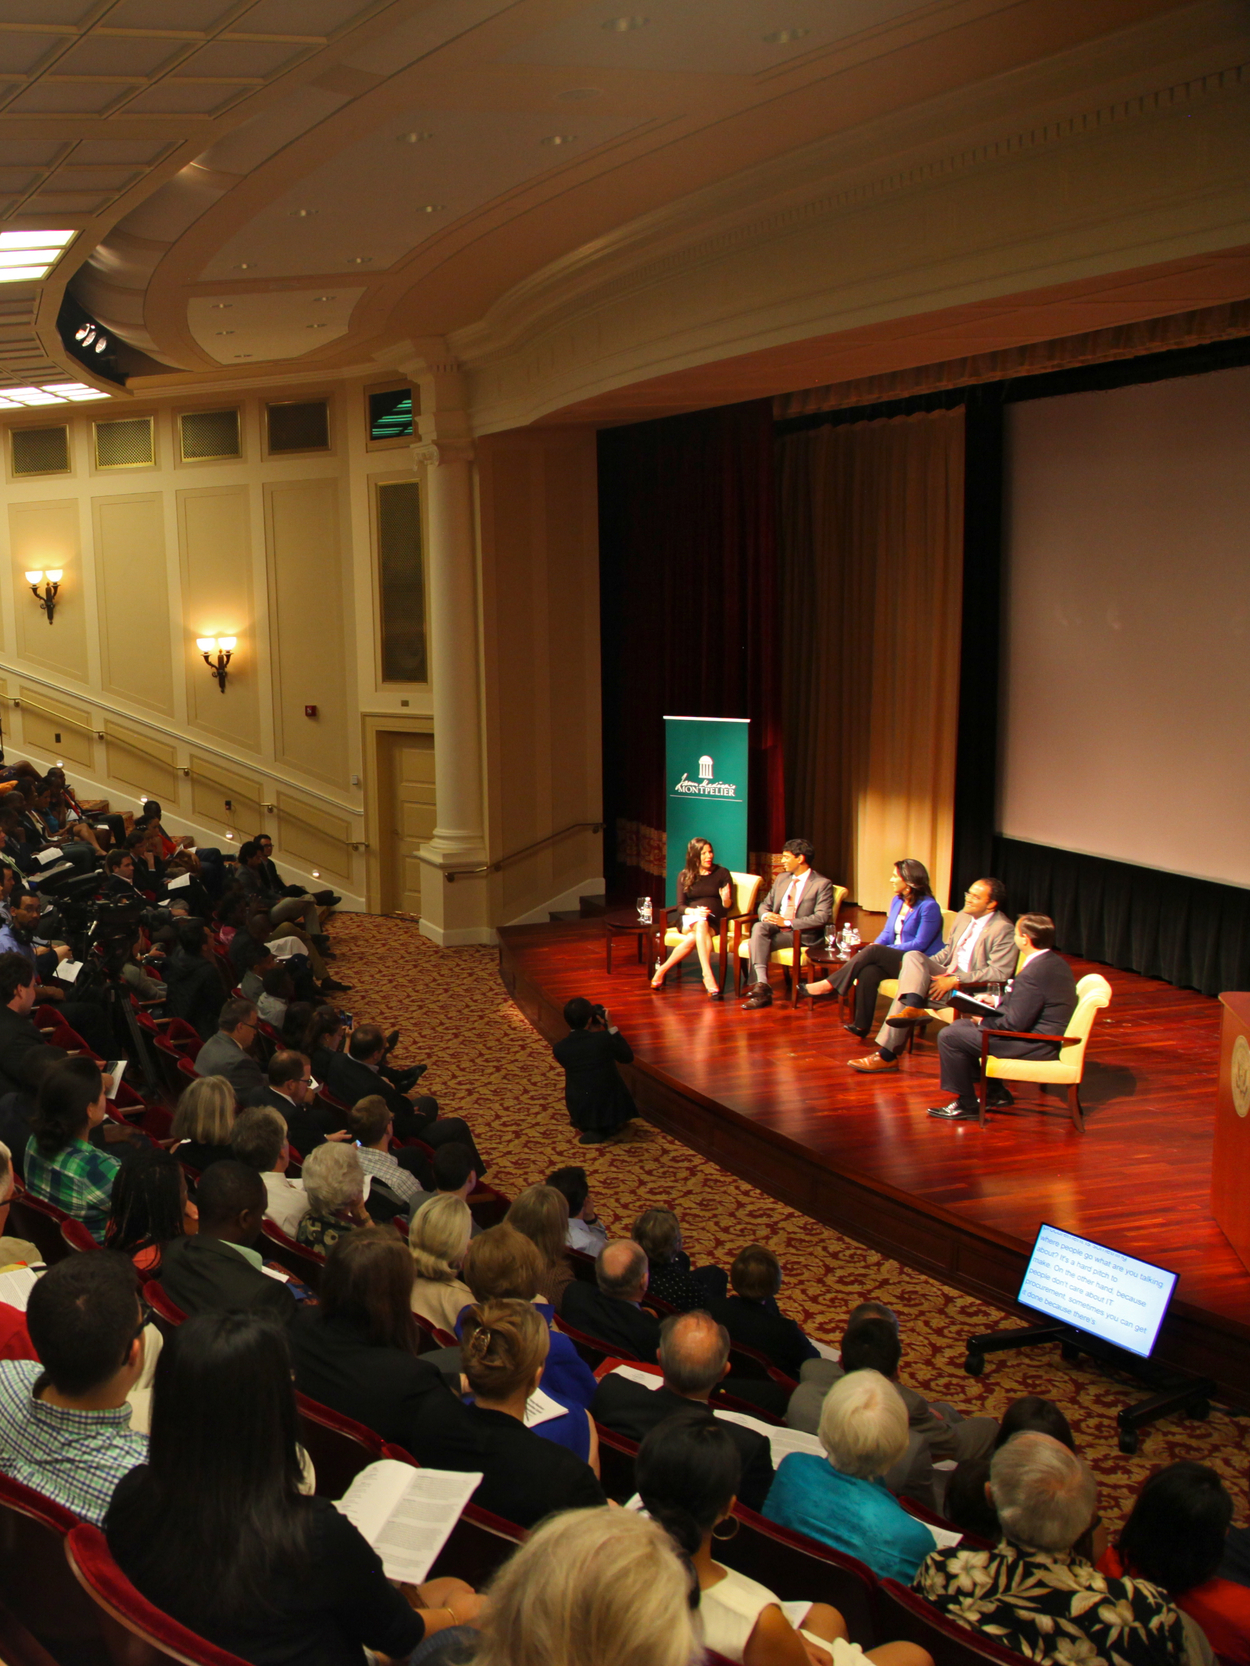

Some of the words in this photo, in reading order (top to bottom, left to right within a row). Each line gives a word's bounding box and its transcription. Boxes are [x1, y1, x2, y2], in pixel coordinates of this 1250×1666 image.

[678, 786, 736, 797] MONTPELIER
[1036, 1246, 1060, 1258] about?
[1076, 1261, 1093, 1273] hard
[1092, 1268, 1110, 1279] pitch
[1039, 1235, 1060, 1248] where
[1060, 1243, 1084, 1257] people
[1094, 1256, 1112, 1268] what
[1111, 1263, 1124, 1273] are
[1124, 1269, 1139, 1278] you
[1139, 1273, 1164, 1289] talking
[1028, 1267, 1051, 1281] people
[1051, 1277, 1069, 1288] don't
[1068, 1284, 1084, 1295] care
[1084, 1291, 1105, 1303] about
[1064, 1269, 1076, 1279] the
[1076, 1275, 1095, 1286] other
[1116, 1290, 1147, 1308] because
[1026, 1291, 1044, 1303] done
[1043, 1298, 1072, 1315] because
[1073, 1310, 1096, 1325] there's
[1068, 1296, 1105, 1316] sometimes
[1105, 1312, 1119, 1322] you
[1119, 1318, 1134, 1328] can
[1134, 1324, 1147, 1334] get
